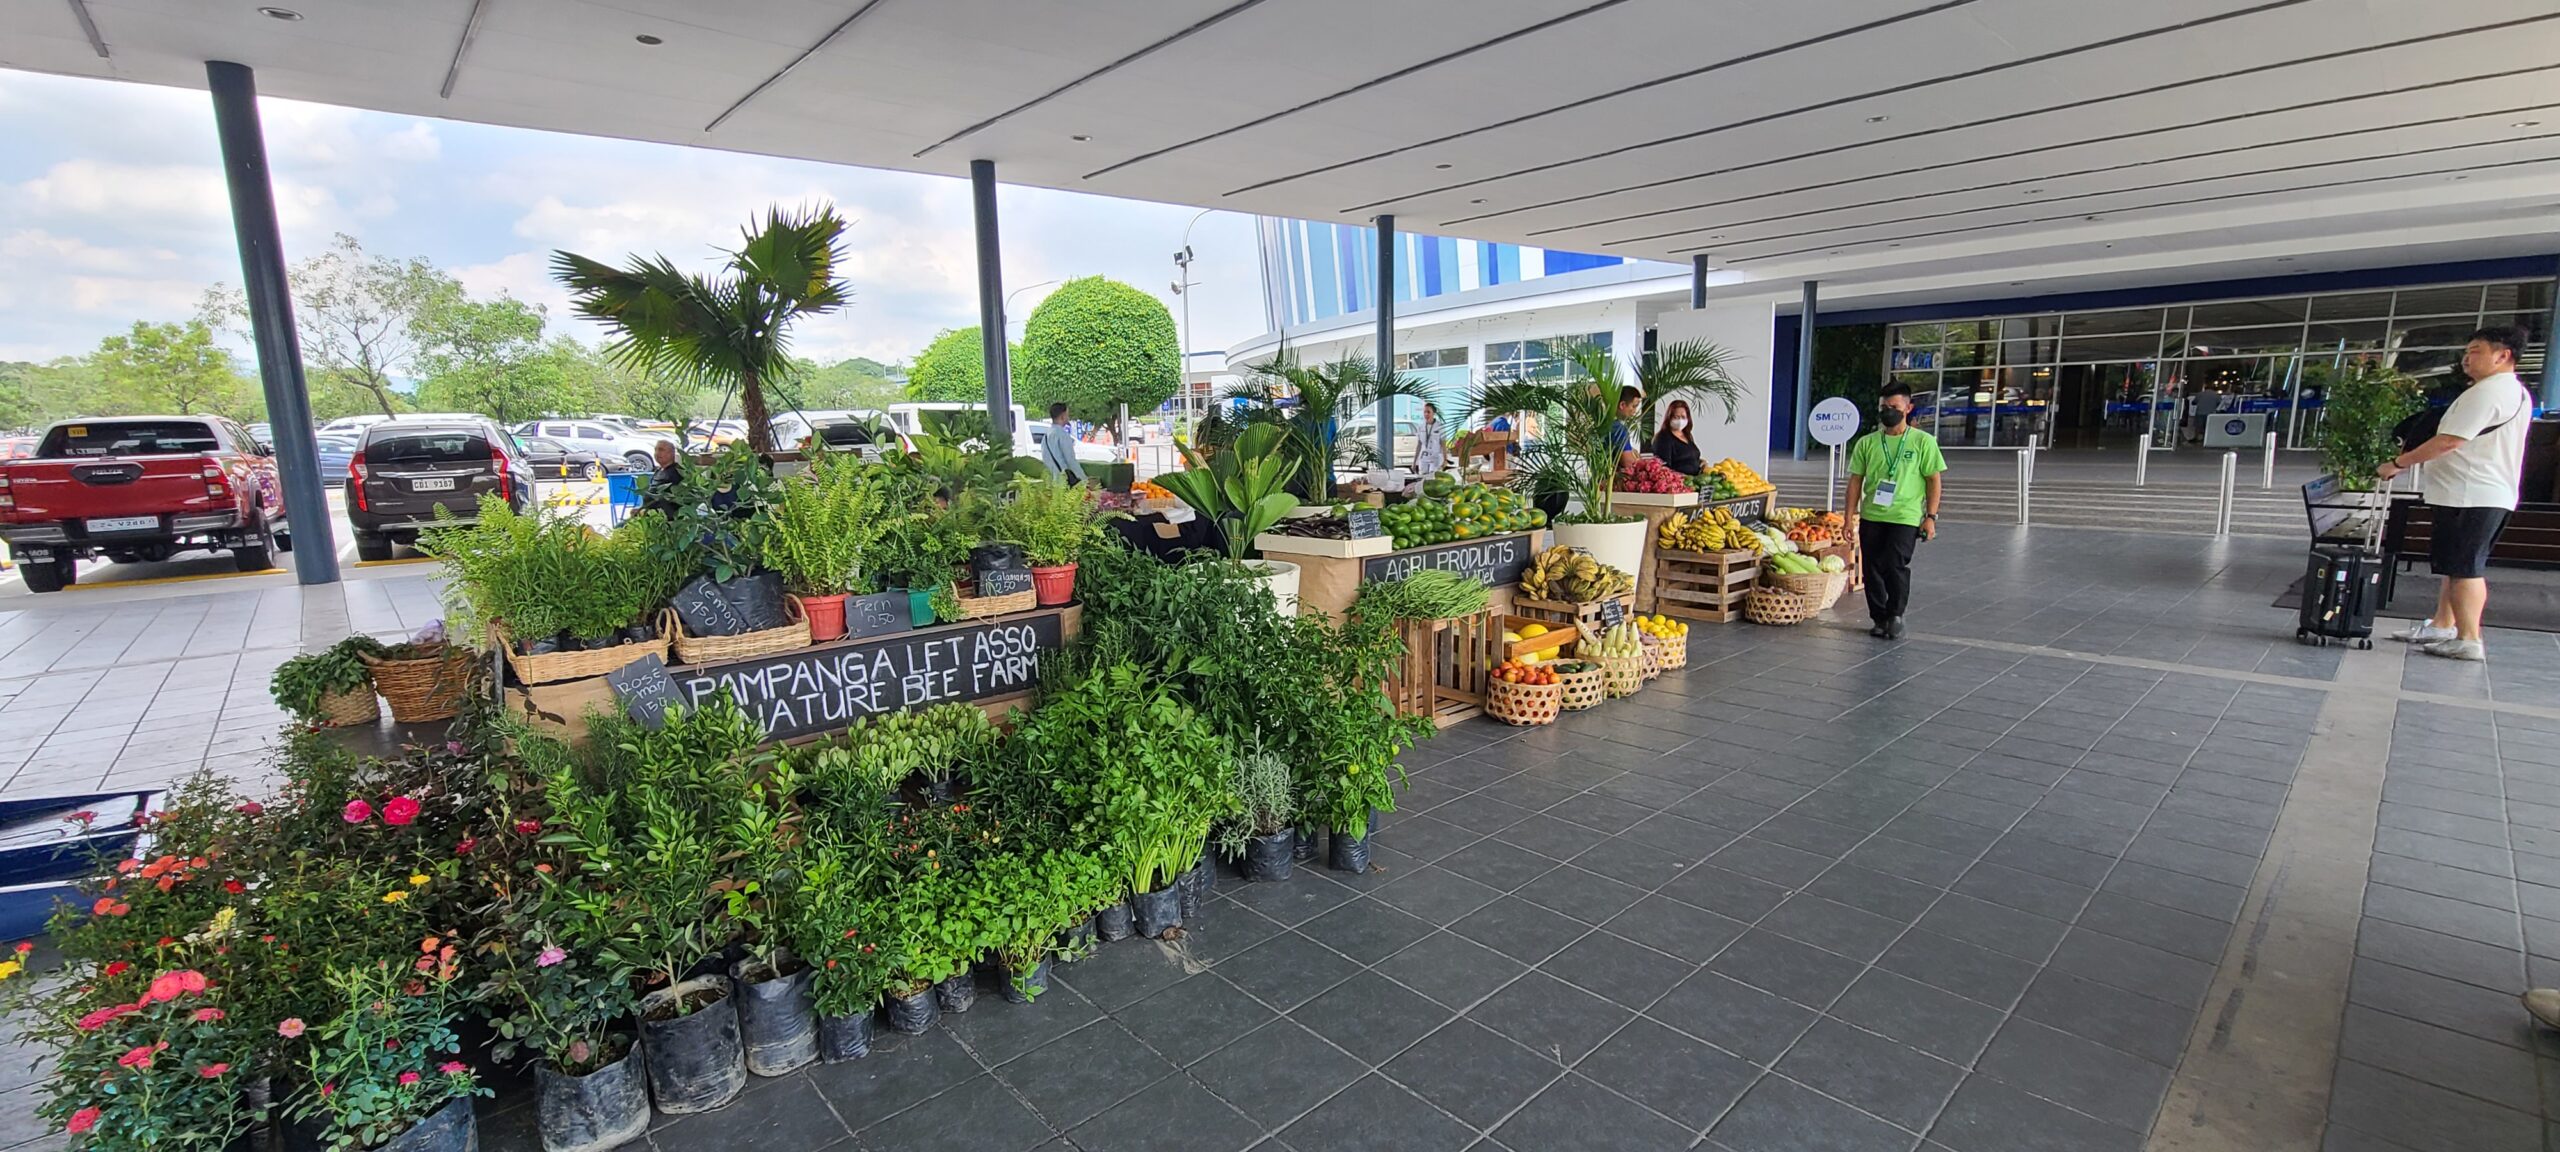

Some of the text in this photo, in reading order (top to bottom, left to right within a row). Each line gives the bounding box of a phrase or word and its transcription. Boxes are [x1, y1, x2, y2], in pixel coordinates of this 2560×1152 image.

[1815, 412, 1852, 421] SM CITY
[1384, 540, 1514, 583] AGRI PRODUCTS
[994, 581, 1016, 594] 250
[690, 600, 718, 626] 450
[867, 612, 896, 628] 250
[616, 667, 661, 695] ROSE
[685, 647, 897, 713] PAMPANGA
[906, 636, 965, 675] LFT
[901, 668, 961, 705] BEE
[971, 652, 1040, 694] FARM
